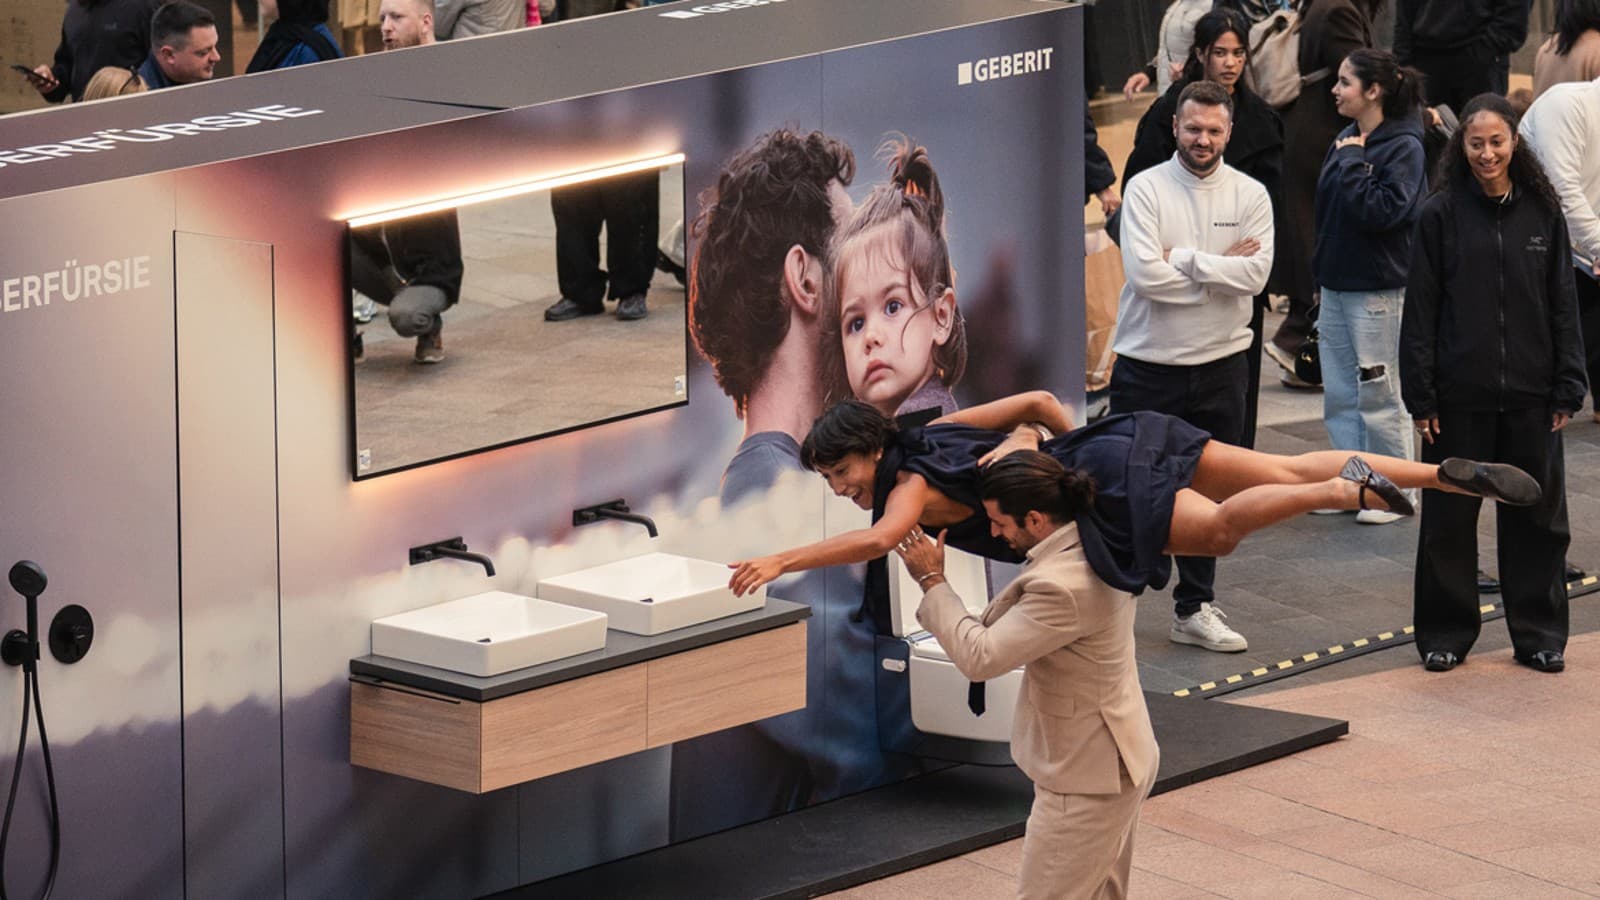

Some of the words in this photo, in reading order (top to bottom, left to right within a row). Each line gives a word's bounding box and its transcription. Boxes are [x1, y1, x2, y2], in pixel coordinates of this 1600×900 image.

[974, 47, 1053, 82] GEBERIT
[0, 104, 325, 168] ERFÜRSIE
[0, 255, 150, 313] ERFÜRSIE
